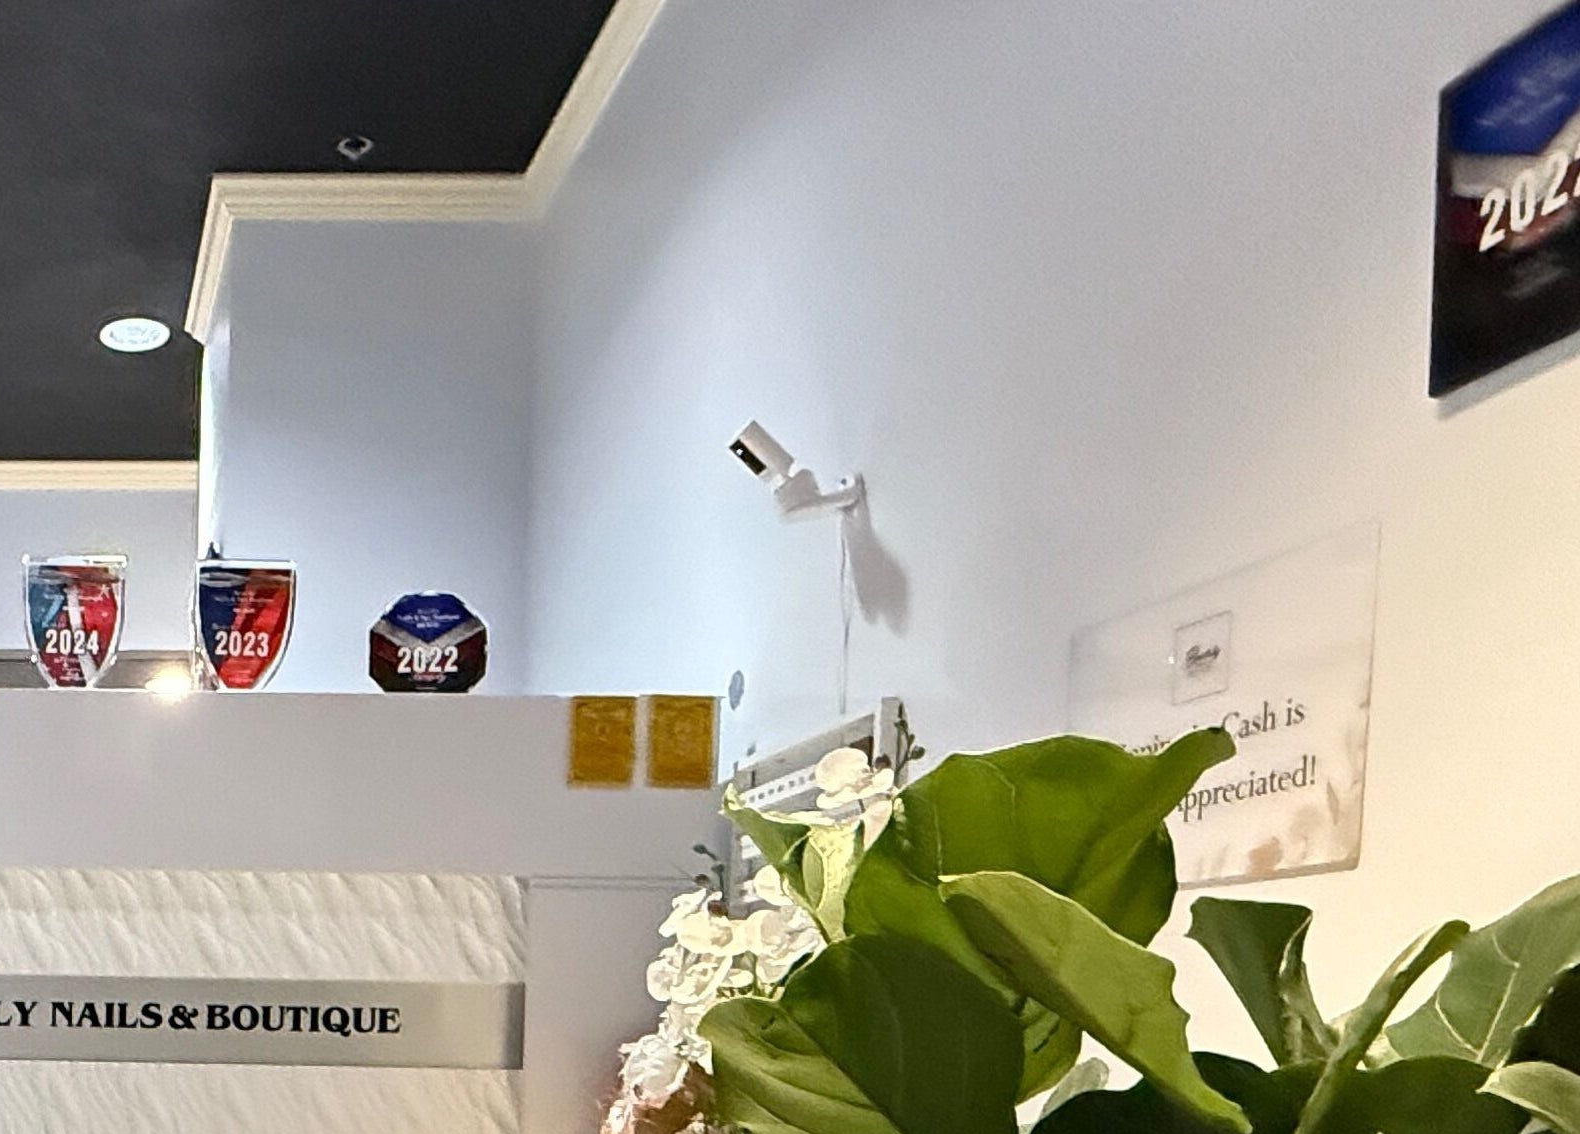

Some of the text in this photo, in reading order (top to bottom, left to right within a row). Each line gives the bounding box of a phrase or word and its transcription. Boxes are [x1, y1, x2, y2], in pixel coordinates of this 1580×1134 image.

[1478, 142, 1580, 253] 202
[45, 628, 99, 656] 2024
[214, 630, 269, 658] 2023
[397, 645, 459, 674] 2022
[1221, 698, 1307, 739] Cash is
[49, 1001, 163, 1029] NAILS
[204, 1004, 402, 1038] BOUTIQUE
